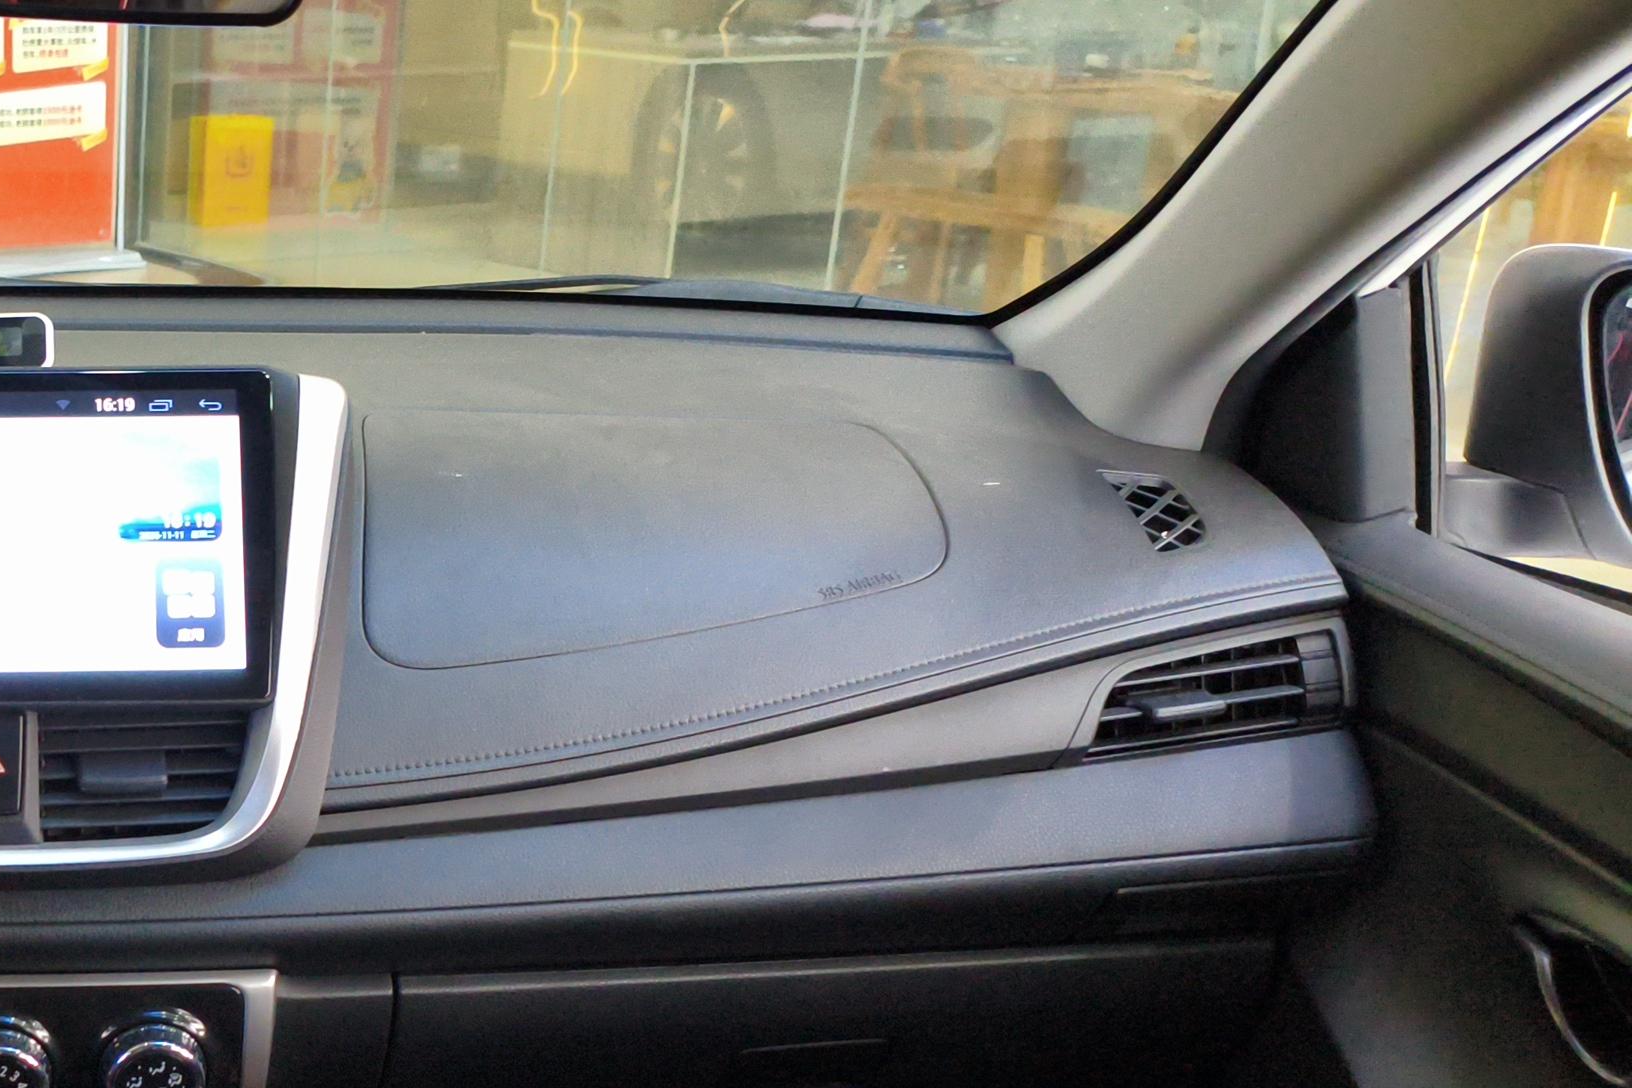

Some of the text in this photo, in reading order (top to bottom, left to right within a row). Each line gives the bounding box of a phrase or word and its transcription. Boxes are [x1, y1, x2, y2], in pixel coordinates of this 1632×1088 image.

[94, 397, 136, 412] 16:19
[0, 1065, 8, 1078] 2
[9, 1070, 20, 1082] 3
